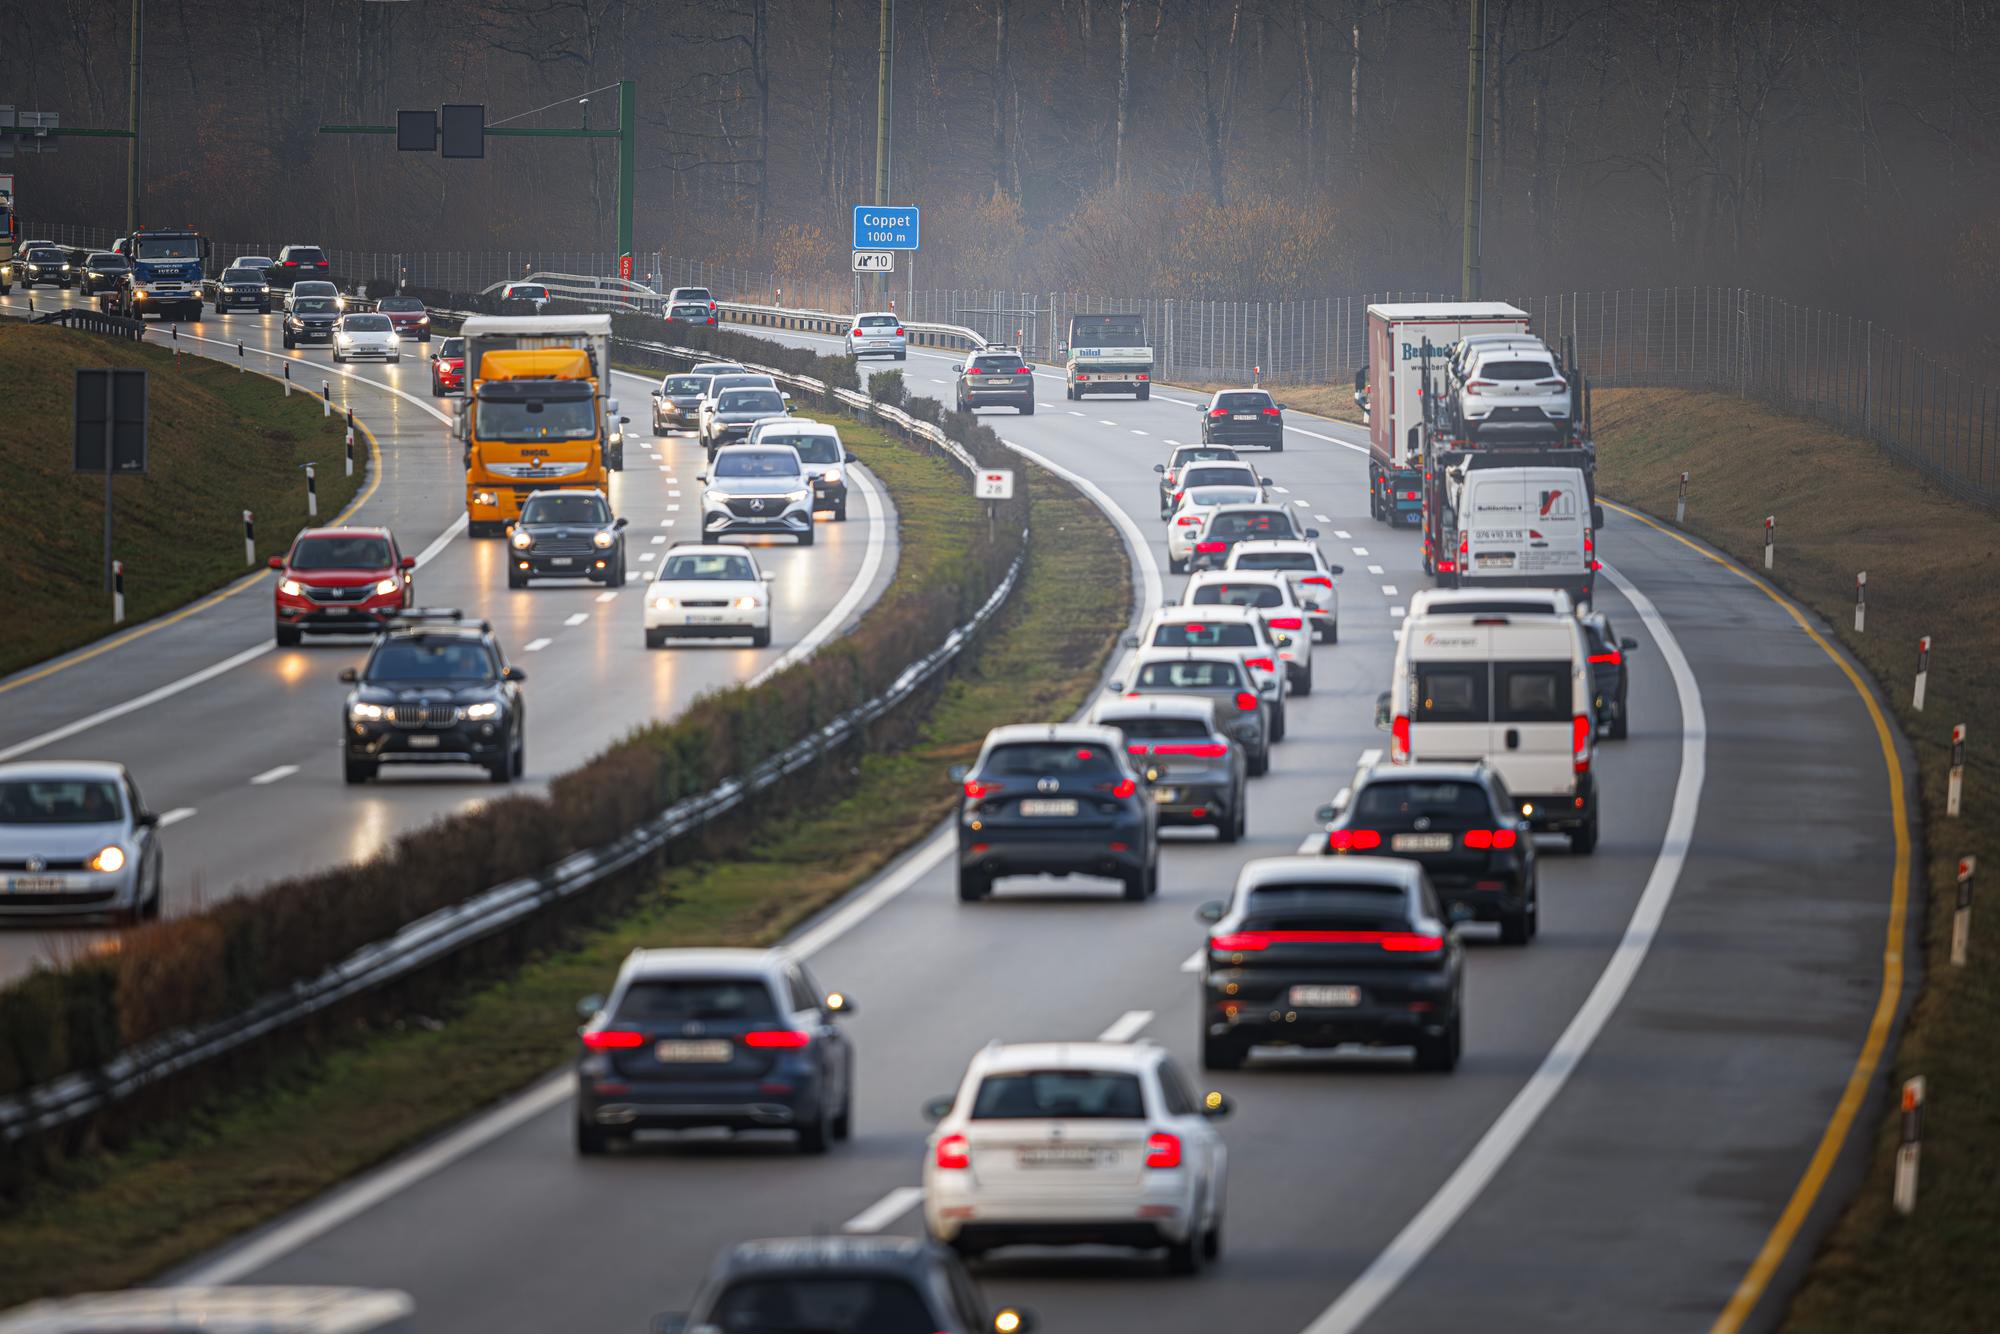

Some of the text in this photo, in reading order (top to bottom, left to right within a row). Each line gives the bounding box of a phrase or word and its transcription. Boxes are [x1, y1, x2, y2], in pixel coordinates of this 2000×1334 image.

[863, 214, 910, 228] Coppet
[867, 232, 906, 242] 1000 m
[874, 255, 888, 267] 10
[986, 484, 1002, 494] 28
